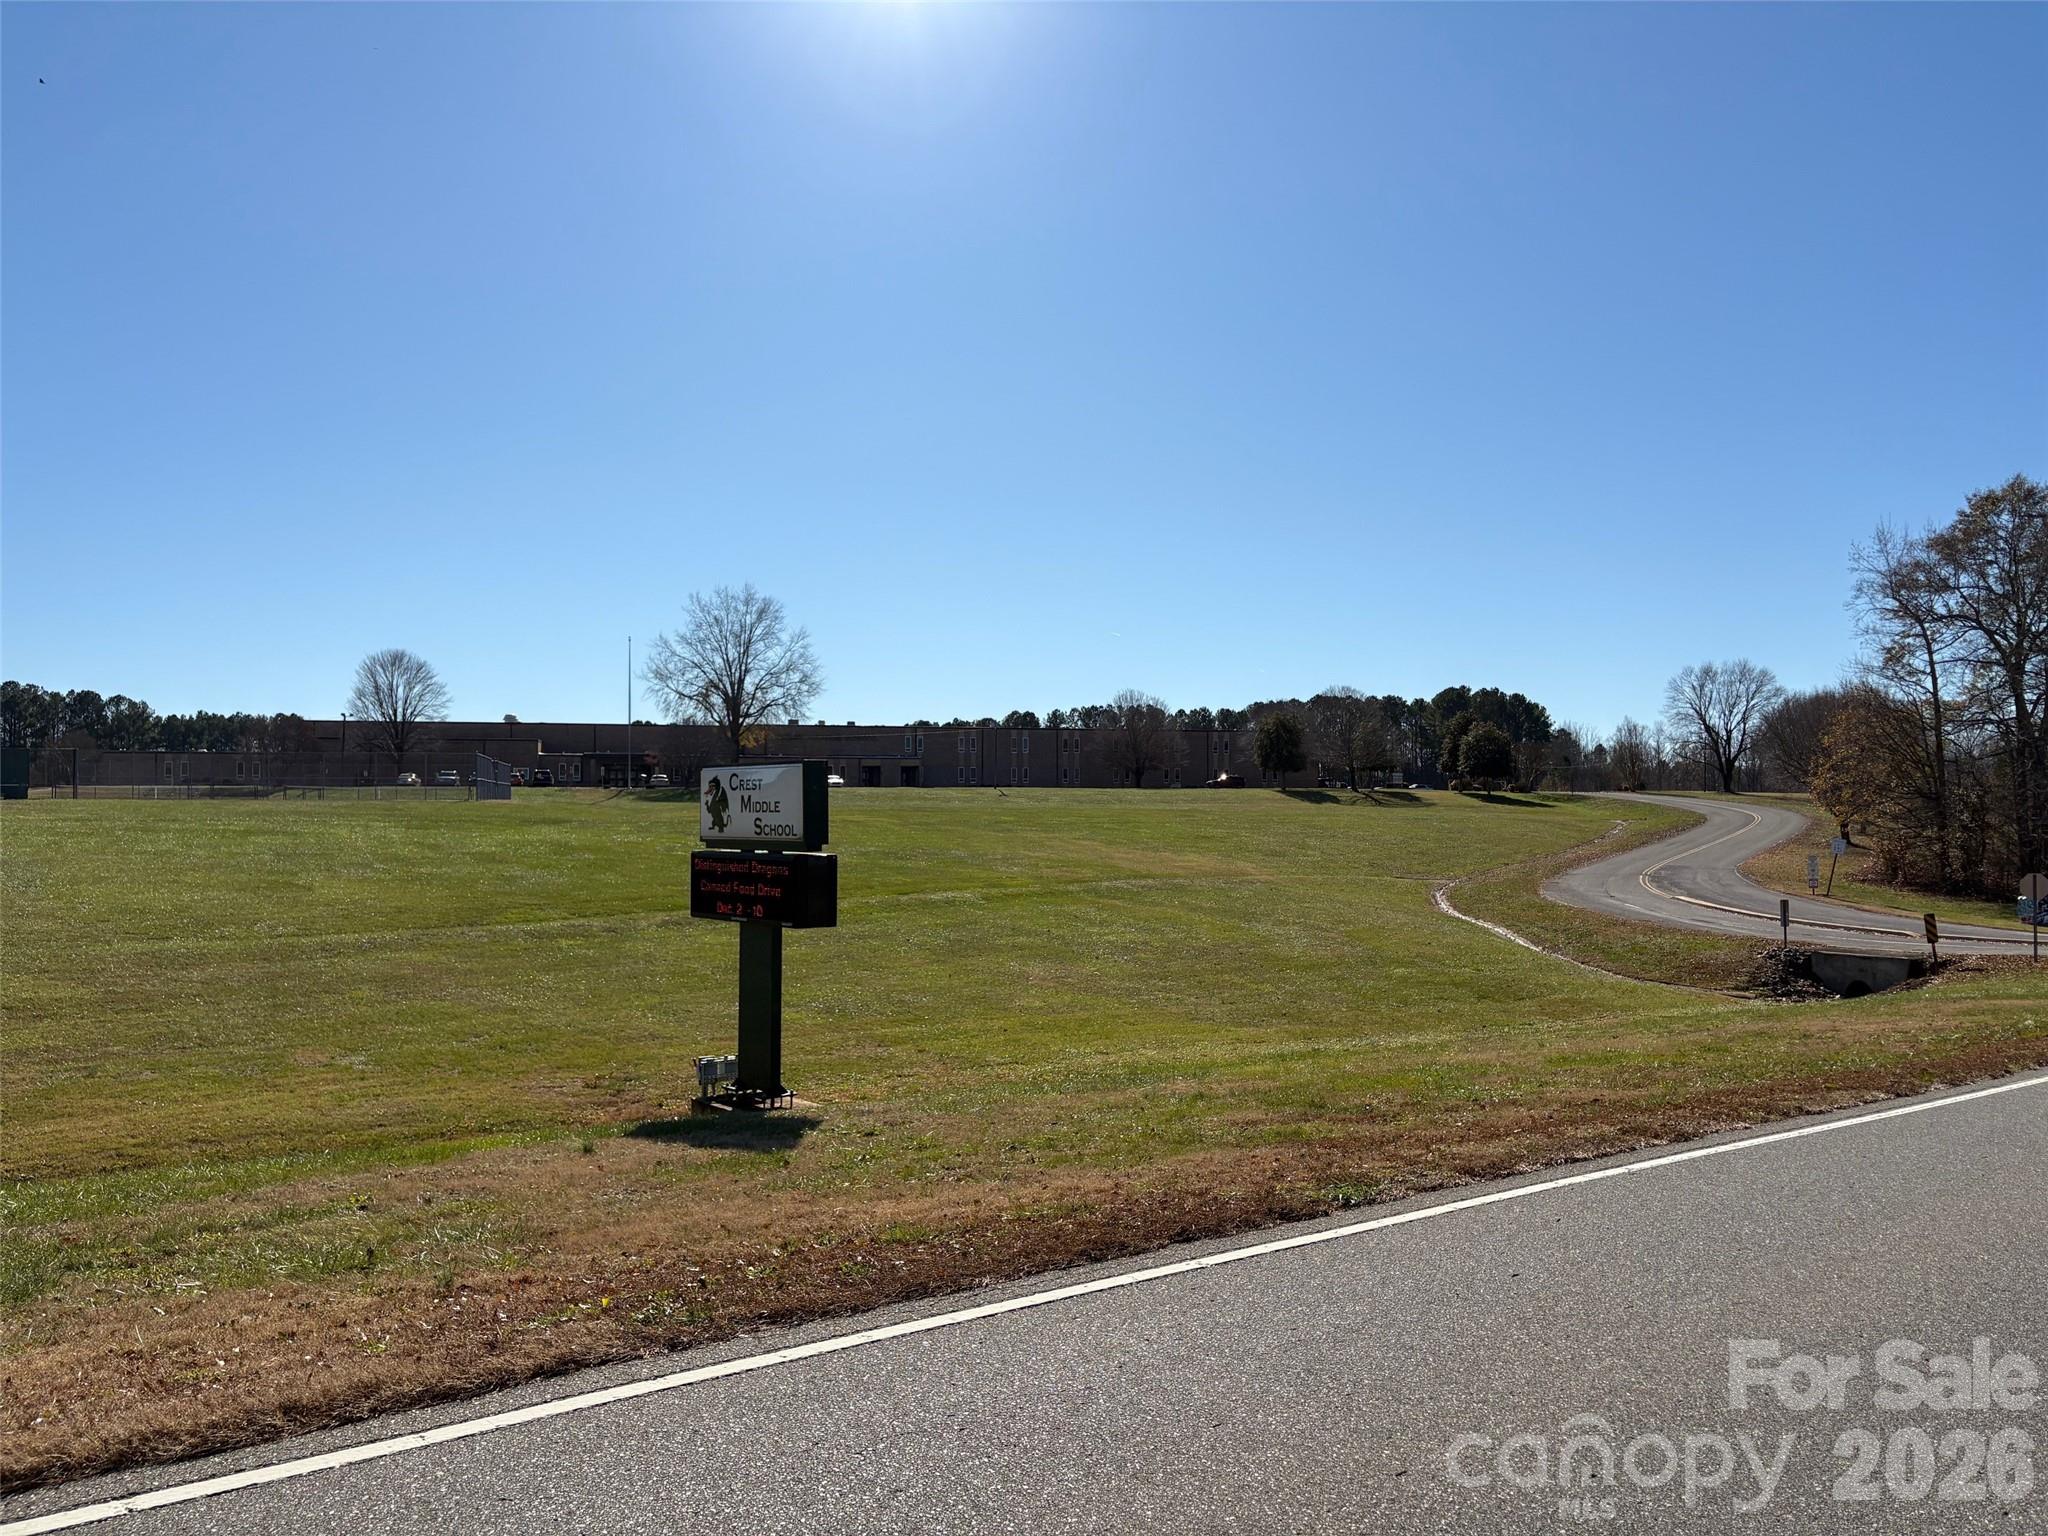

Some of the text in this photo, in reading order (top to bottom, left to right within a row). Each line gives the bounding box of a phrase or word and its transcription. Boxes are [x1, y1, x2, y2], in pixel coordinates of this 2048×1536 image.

[729, 773, 763, 791] CREST
[740, 795, 781, 813] MIDDLE
[754, 817, 798, 837] SCHOOL
